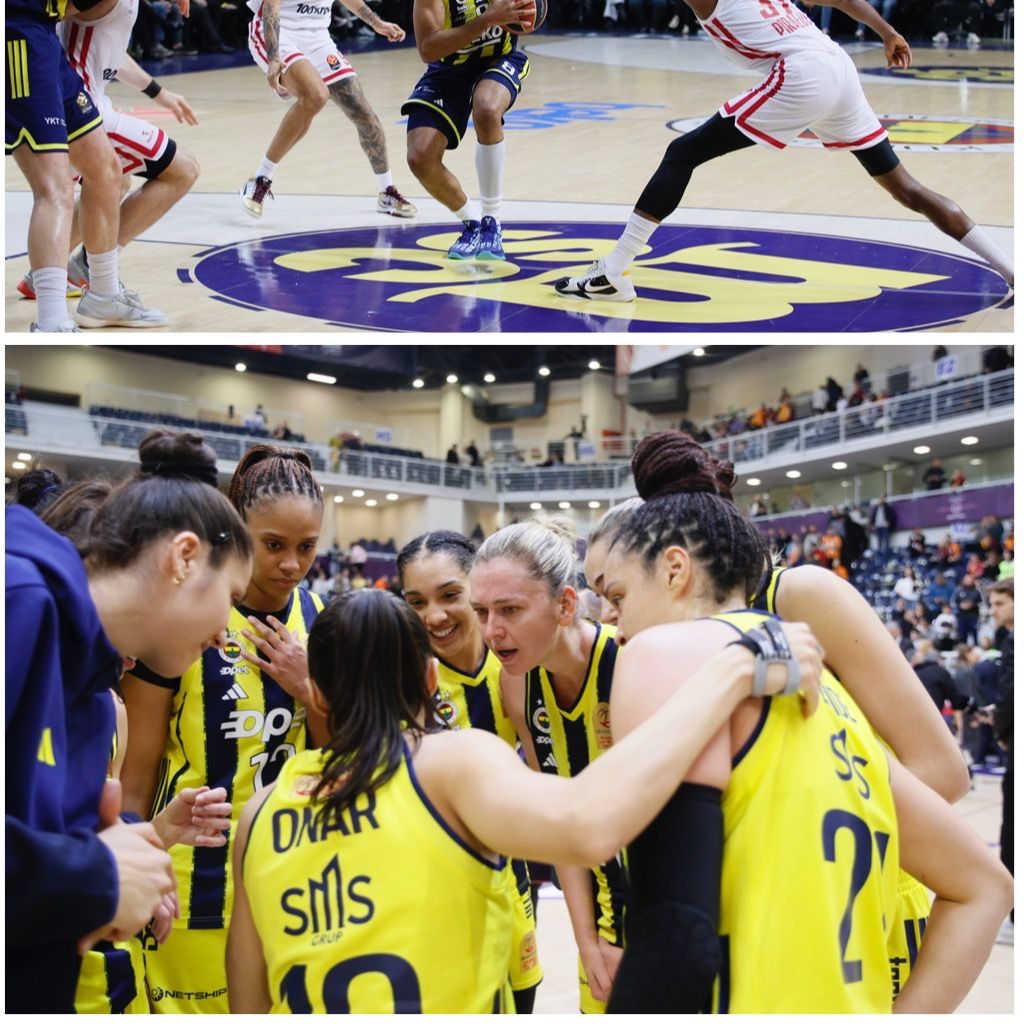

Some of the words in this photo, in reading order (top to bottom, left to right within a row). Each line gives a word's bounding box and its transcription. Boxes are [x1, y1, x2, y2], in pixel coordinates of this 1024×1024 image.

[501, 61, 516, 75] 8
[220, 665, 250, 676] opet
[272, 788, 380, 854] ONAR
[280, 853, 375, 936] SMS
[311, 930, 344, 946] GRUP
[165, 987, 228, 1001] NETSHIP
